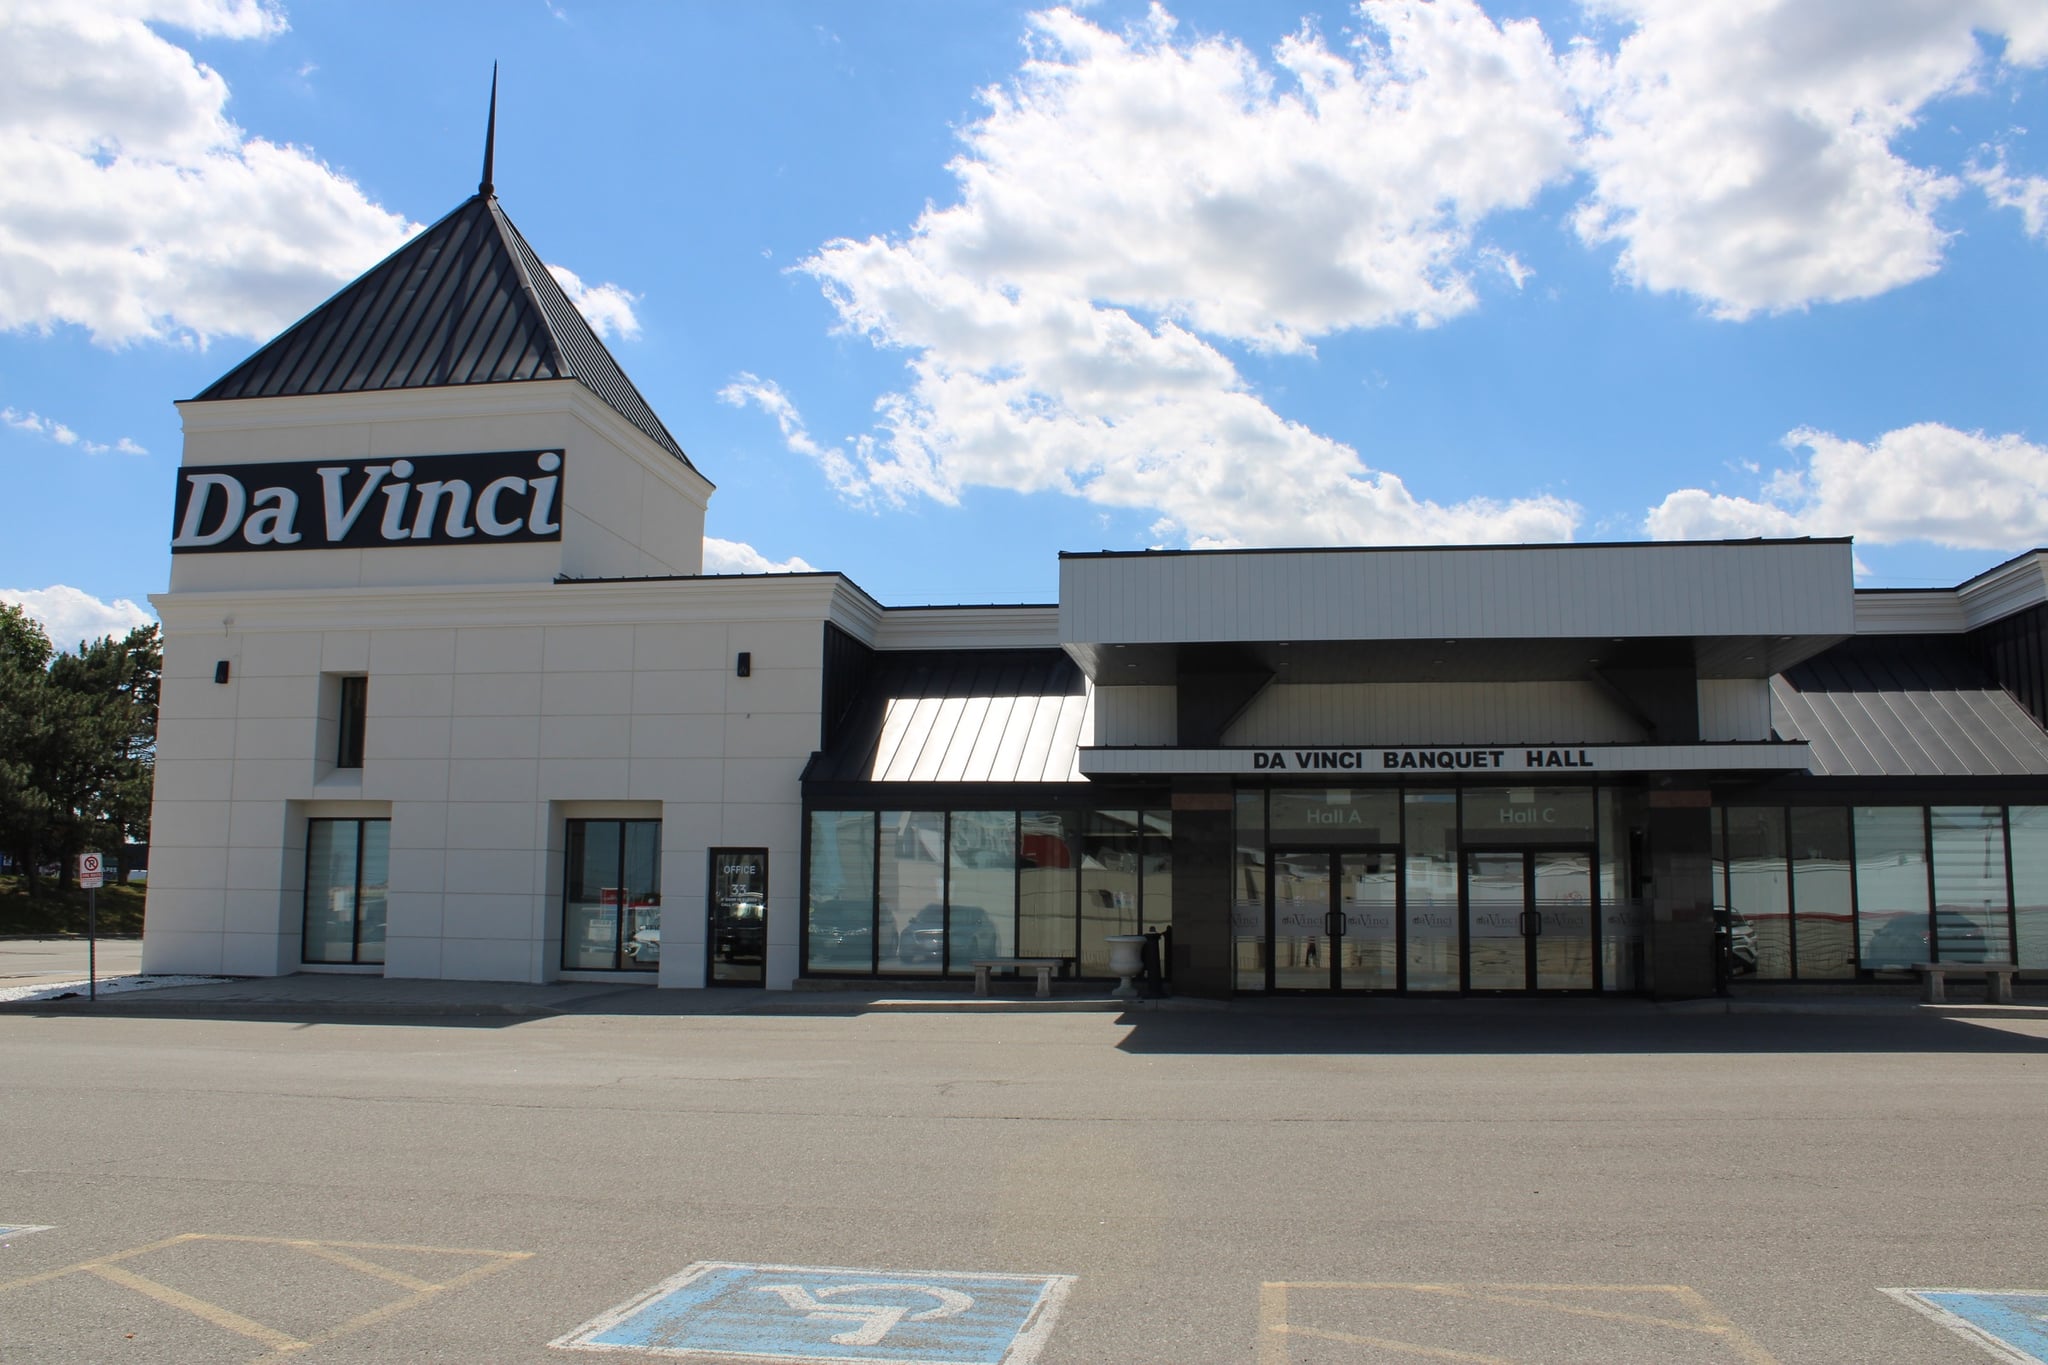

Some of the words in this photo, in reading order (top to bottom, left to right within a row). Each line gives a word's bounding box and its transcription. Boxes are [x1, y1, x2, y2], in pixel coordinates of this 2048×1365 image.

[172, 472, 302, 547] Da
[316, 452, 561, 542] Vinci
[1253, 751, 1286, 769] DA
[1295, 751, 1362, 769] VINCI
[1383, 750, 1504, 770] BANQUET
[1526, 749, 1593, 767] HALL
[1307, 808, 1343, 824] Hall
[1347, 808, 1362, 824] A
[1499, 807, 1536, 823] Hall
[1542, 808, 1556, 823] C
[723, 865, 756, 874] OFFICE
[731, 884, 747, 895] 33
